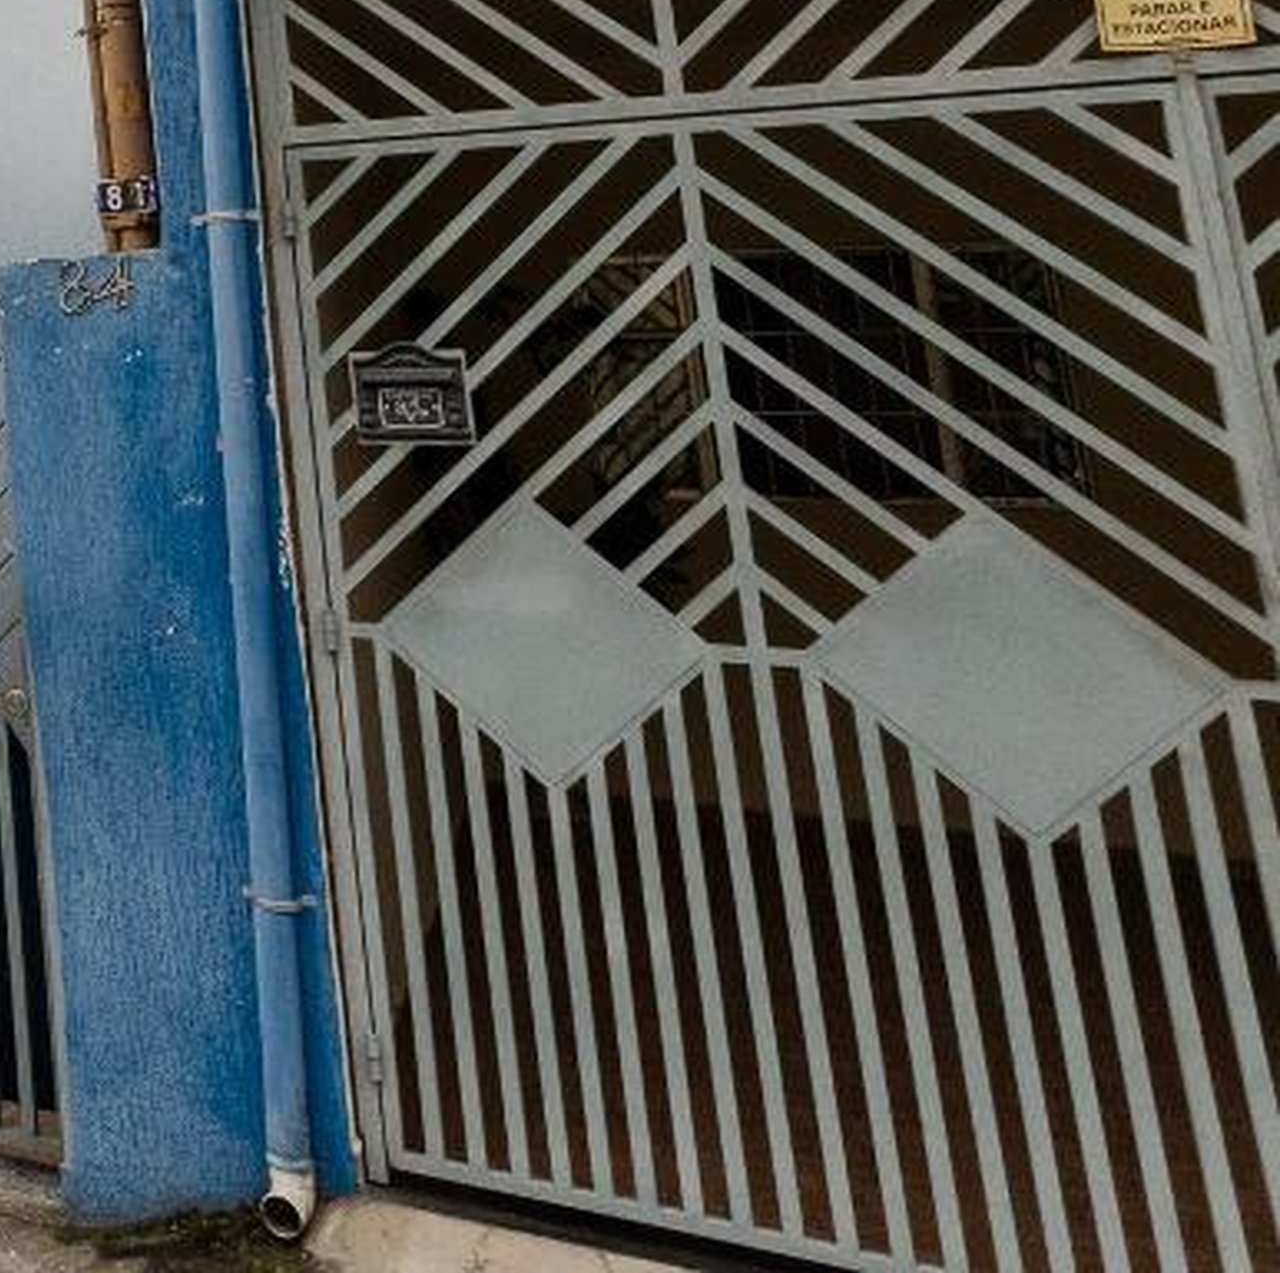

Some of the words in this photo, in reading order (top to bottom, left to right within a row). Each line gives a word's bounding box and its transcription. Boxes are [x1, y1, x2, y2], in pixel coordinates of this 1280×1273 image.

[1130, 1, 1195, 18] PARAR
[1198, 0, 1212, 14] E
[1112, 15, 1238, 36] ESTACIONAR
